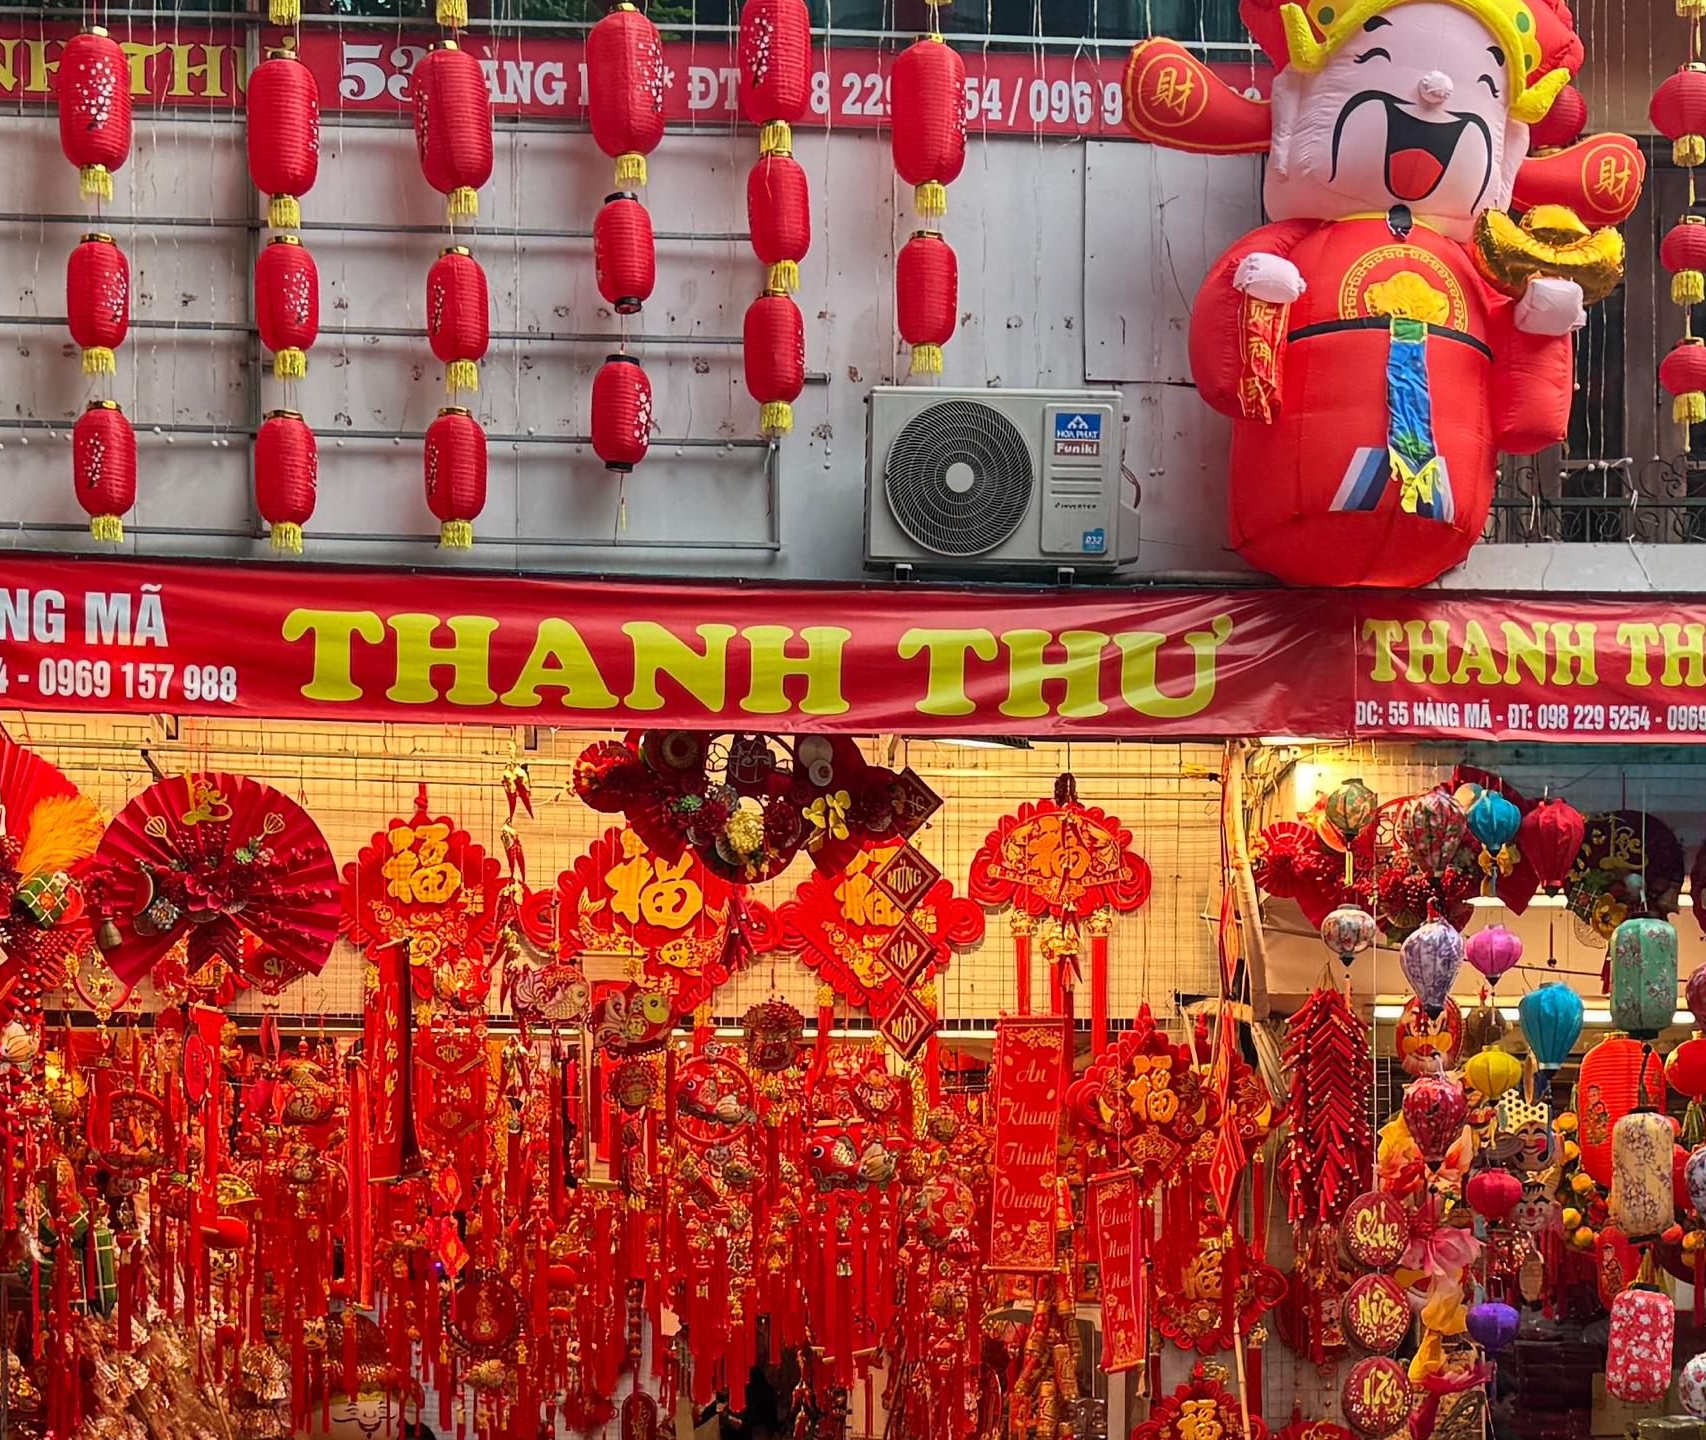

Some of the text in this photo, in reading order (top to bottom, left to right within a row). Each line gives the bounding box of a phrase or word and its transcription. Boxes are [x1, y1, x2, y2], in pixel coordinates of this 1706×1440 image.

[483, 46, 568, 106] ÀNG
[1056, 442, 1098, 455] Funiki
[85, 584, 169, 647] MÃ
[282, 608, 1234, 720] THANH THƯ
[1362, 617, 1599, 688] THANH
[38, 659, 111, 698] 0969
[121, 662, 175, 700] 157
[183, 665, 238, 703] 988
[1355, 700, 1383, 726] ĐC:
[1388, 702, 1409, 727] 55
[1413, 697, 1460, 729] HÀNG
[1464, 699, 1491, 729] MÃ
[1507, 705, 1534, 730] ĐT:
[1538, 706, 1569, 731] 098
[1573, 706, 1605, 731] 229
[1609, 706, 1652, 731] 5254
[1016, 1058, 1049, 1083] An
[1126, 1053, 1180, 1124] 福
[1002, 1101, 1059, 1130] Khang
